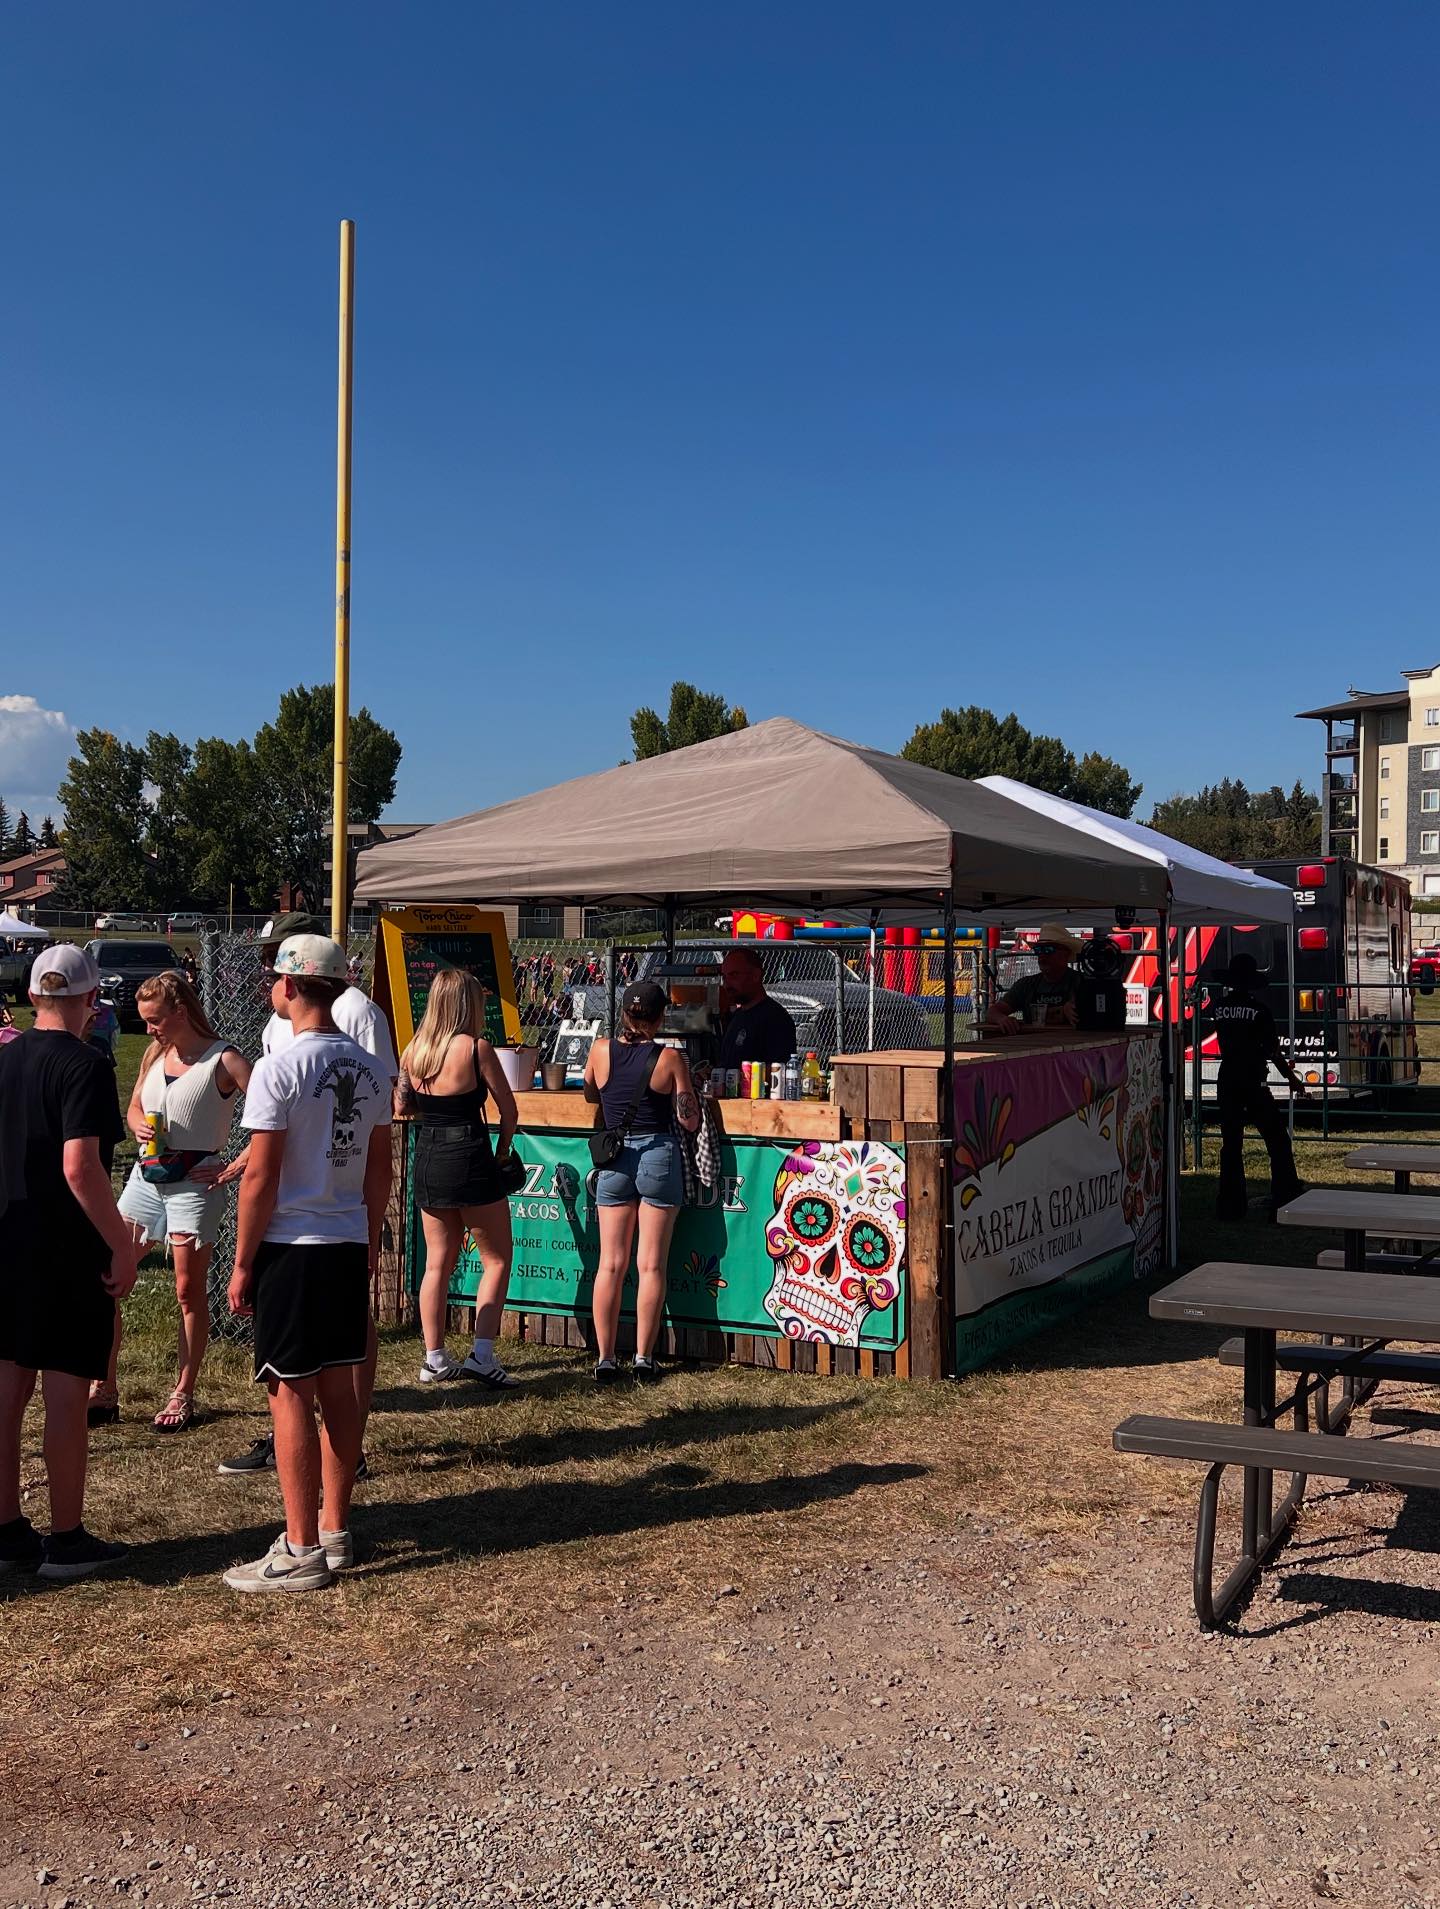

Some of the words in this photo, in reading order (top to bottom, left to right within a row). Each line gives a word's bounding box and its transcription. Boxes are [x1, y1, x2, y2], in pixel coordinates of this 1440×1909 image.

[413, 908, 443, 924] Topo
[445, 908, 475, 925] Chico
[1215, 1006, 1258, 1021] SECURITY
[1305, 1036, 1325, 1046] Us!
[958, 1197, 1043, 1264] CABEZA
[1049, 1170, 1119, 1231] GRANDE
[1009, 1247, 1039, 1278] TACOS
[1048, 1229, 1083, 1259] TEQUILA
[517, 1264, 569, 1283] SIESTA,
